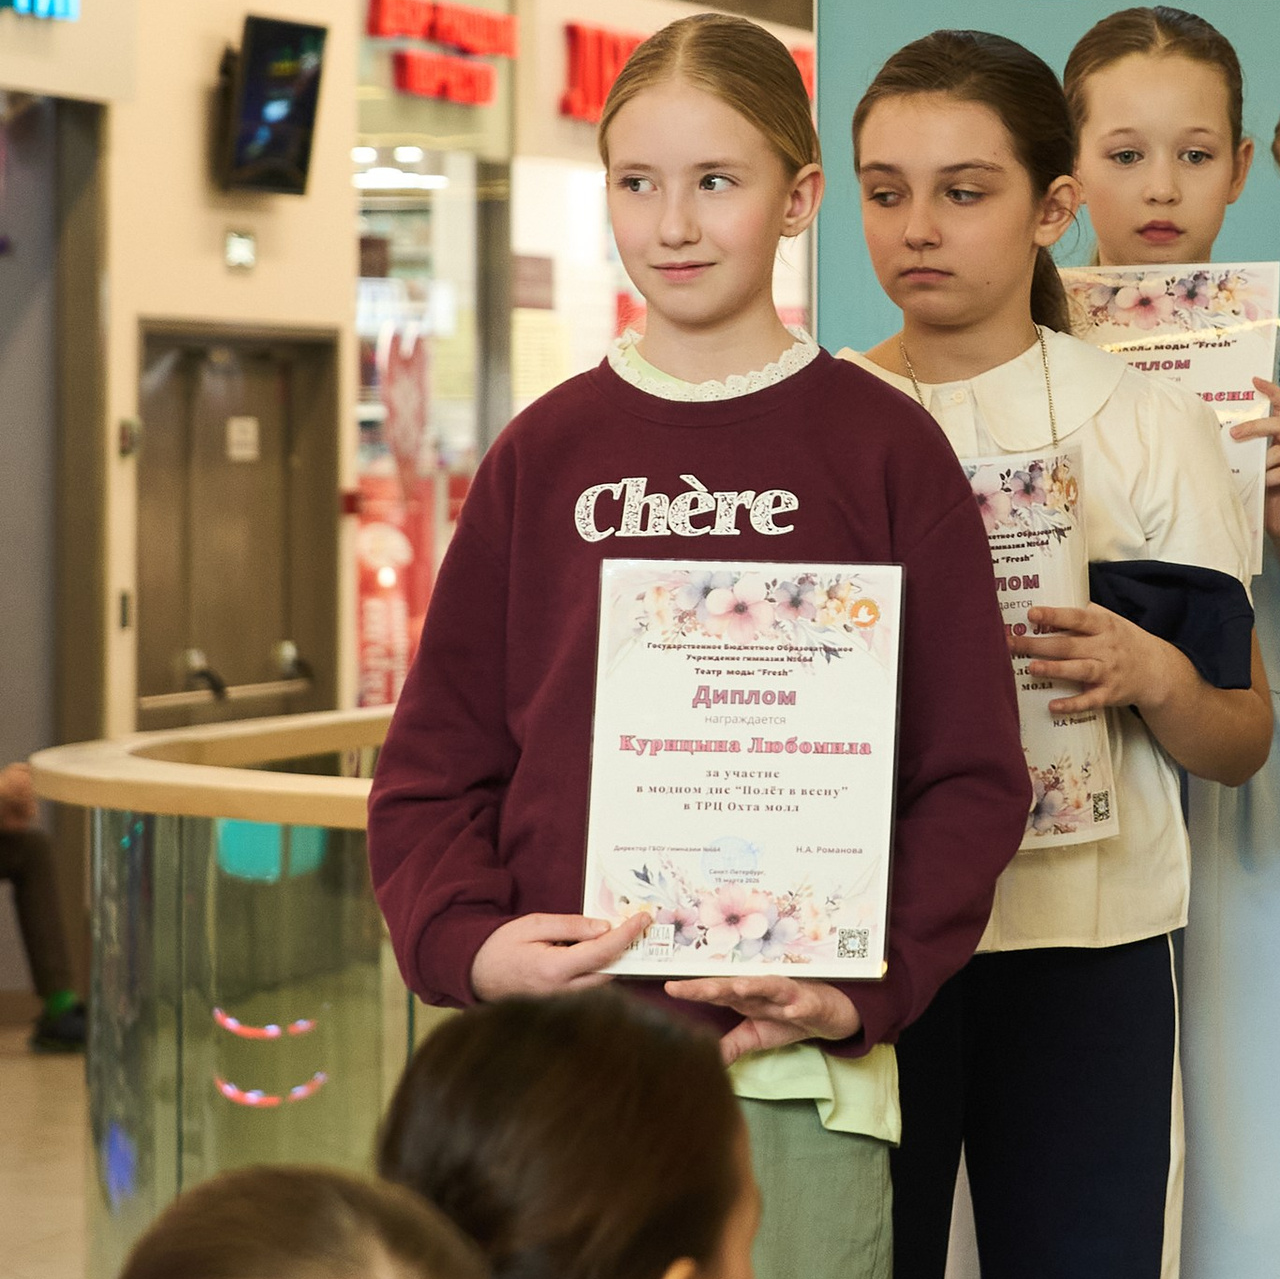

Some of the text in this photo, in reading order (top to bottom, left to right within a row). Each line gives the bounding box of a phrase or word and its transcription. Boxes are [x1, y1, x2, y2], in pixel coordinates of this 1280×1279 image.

[1154, 342, 1190, 352] моды
[574, 474, 799, 542] Chère
[647, 642, 722, 652] Государственное
[724, 643, 775, 652] Бюджетное
[686, 654, 741, 663] Учреждение
[694, 668, 722, 678] Театр
[726, 669, 755, 677] моды
[691, 685, 797, 709] Диплом
[705, 715, 787, 726] награждается
[619, 734, 873, 756] Курицына Любомила
[706, 770, 780, 781] за участие
[648, 786, 702, 796] модном
[695, 801, 723, 812] ТРЦ
[727, 802, 760, 812] Охта
[765, 804, 800, 812] молл
[816, 846, 863, 855] Романова
